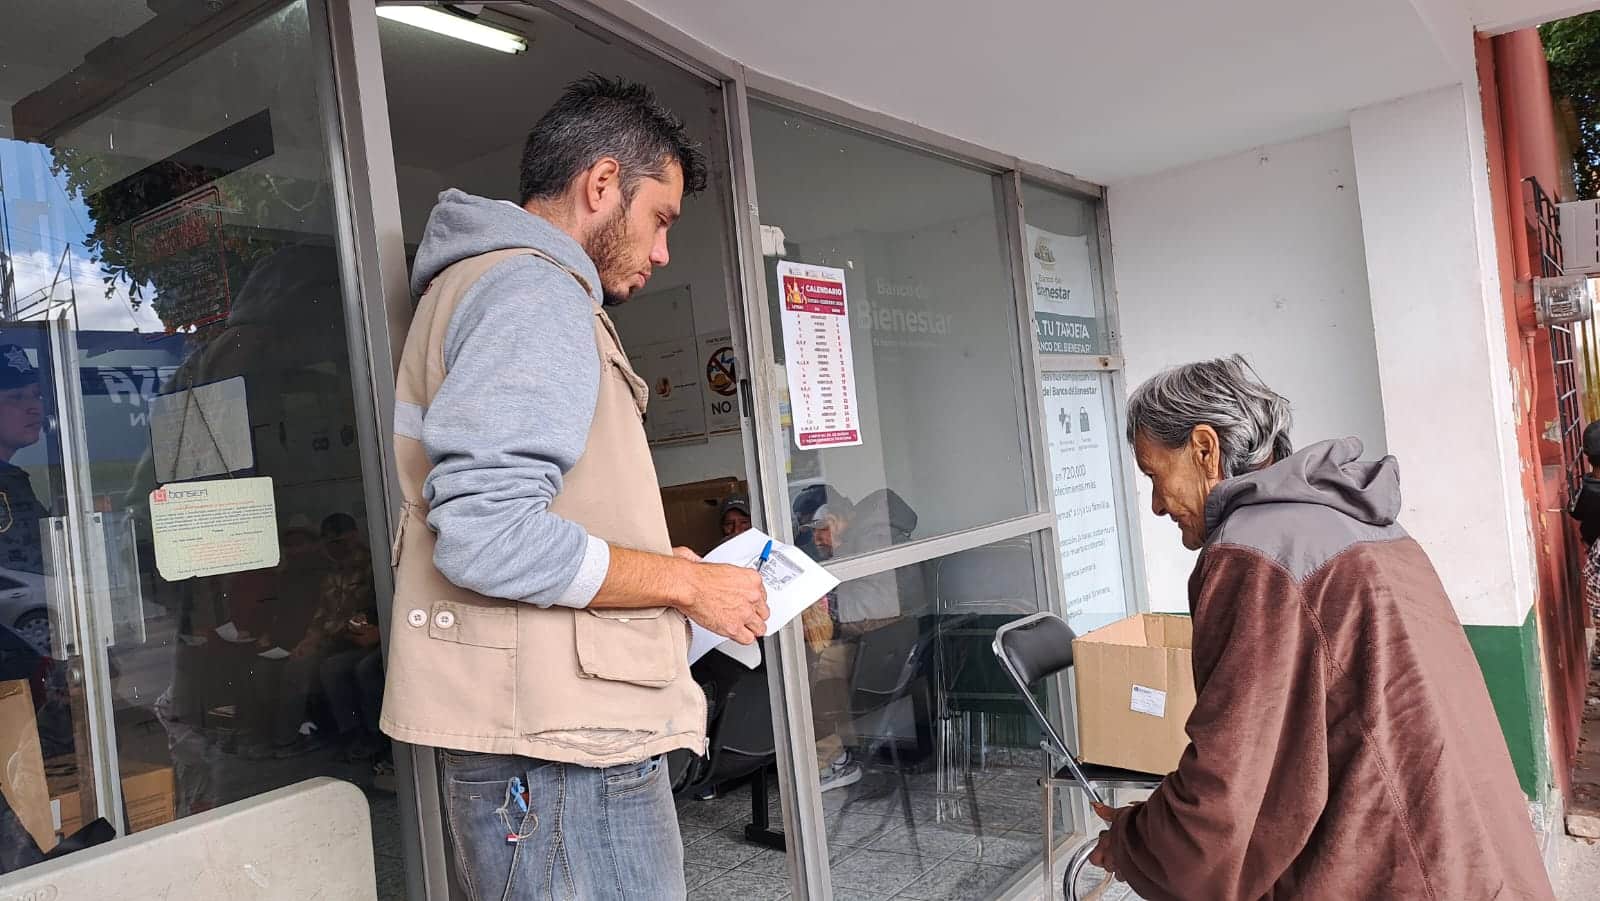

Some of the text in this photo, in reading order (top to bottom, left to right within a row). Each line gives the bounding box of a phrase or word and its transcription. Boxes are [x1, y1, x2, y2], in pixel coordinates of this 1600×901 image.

[805, 284, 842, 296] CALENDARIO
[857, 299, 953, 337] Bienestar
[1042, 319, 1054, 337] TU
[1056, 321, 1090, 339] TARJETA
[711, 401, 732, 416] NO
